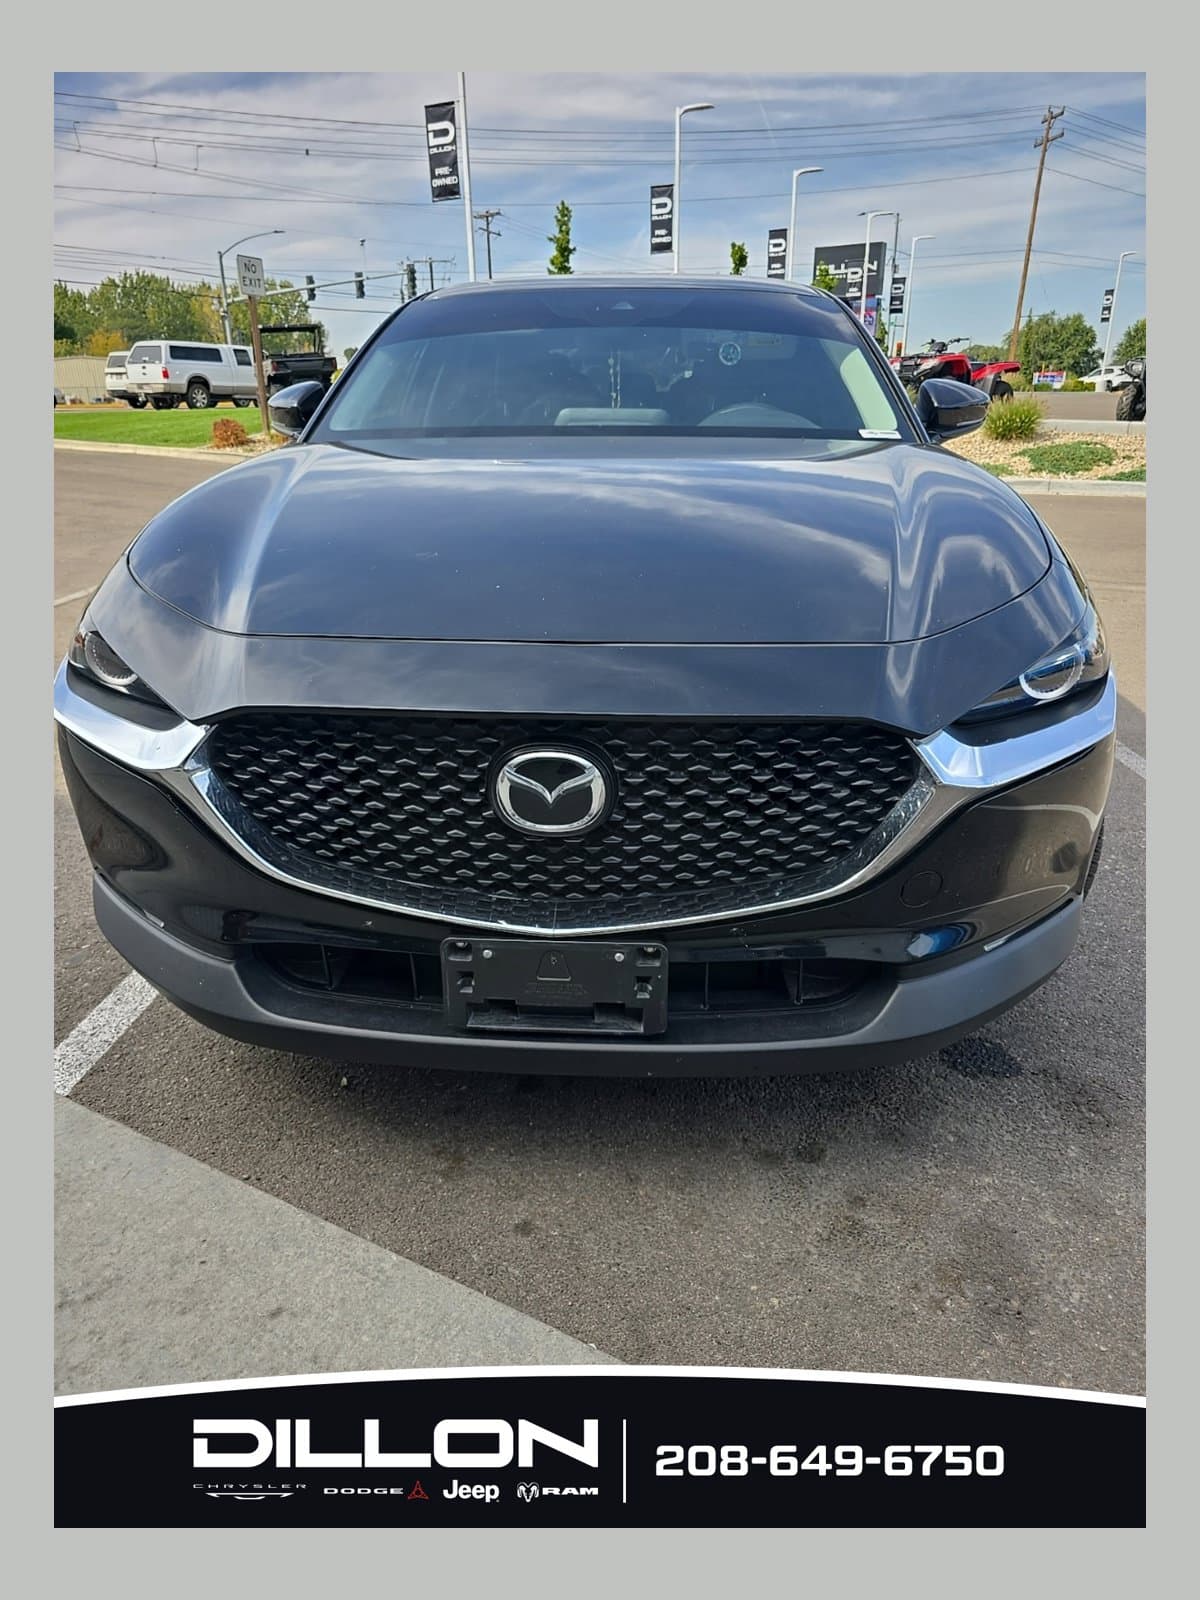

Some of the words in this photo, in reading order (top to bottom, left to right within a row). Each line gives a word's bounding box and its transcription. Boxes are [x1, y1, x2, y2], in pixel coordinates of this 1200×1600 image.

[427, 121, 455, 147] D
[432, 176, 458, 187] OWNED
[651, 197, 672, 215] D
[244, 262, 257, 274] NO
[242, 276, 262, 288] EXIT
